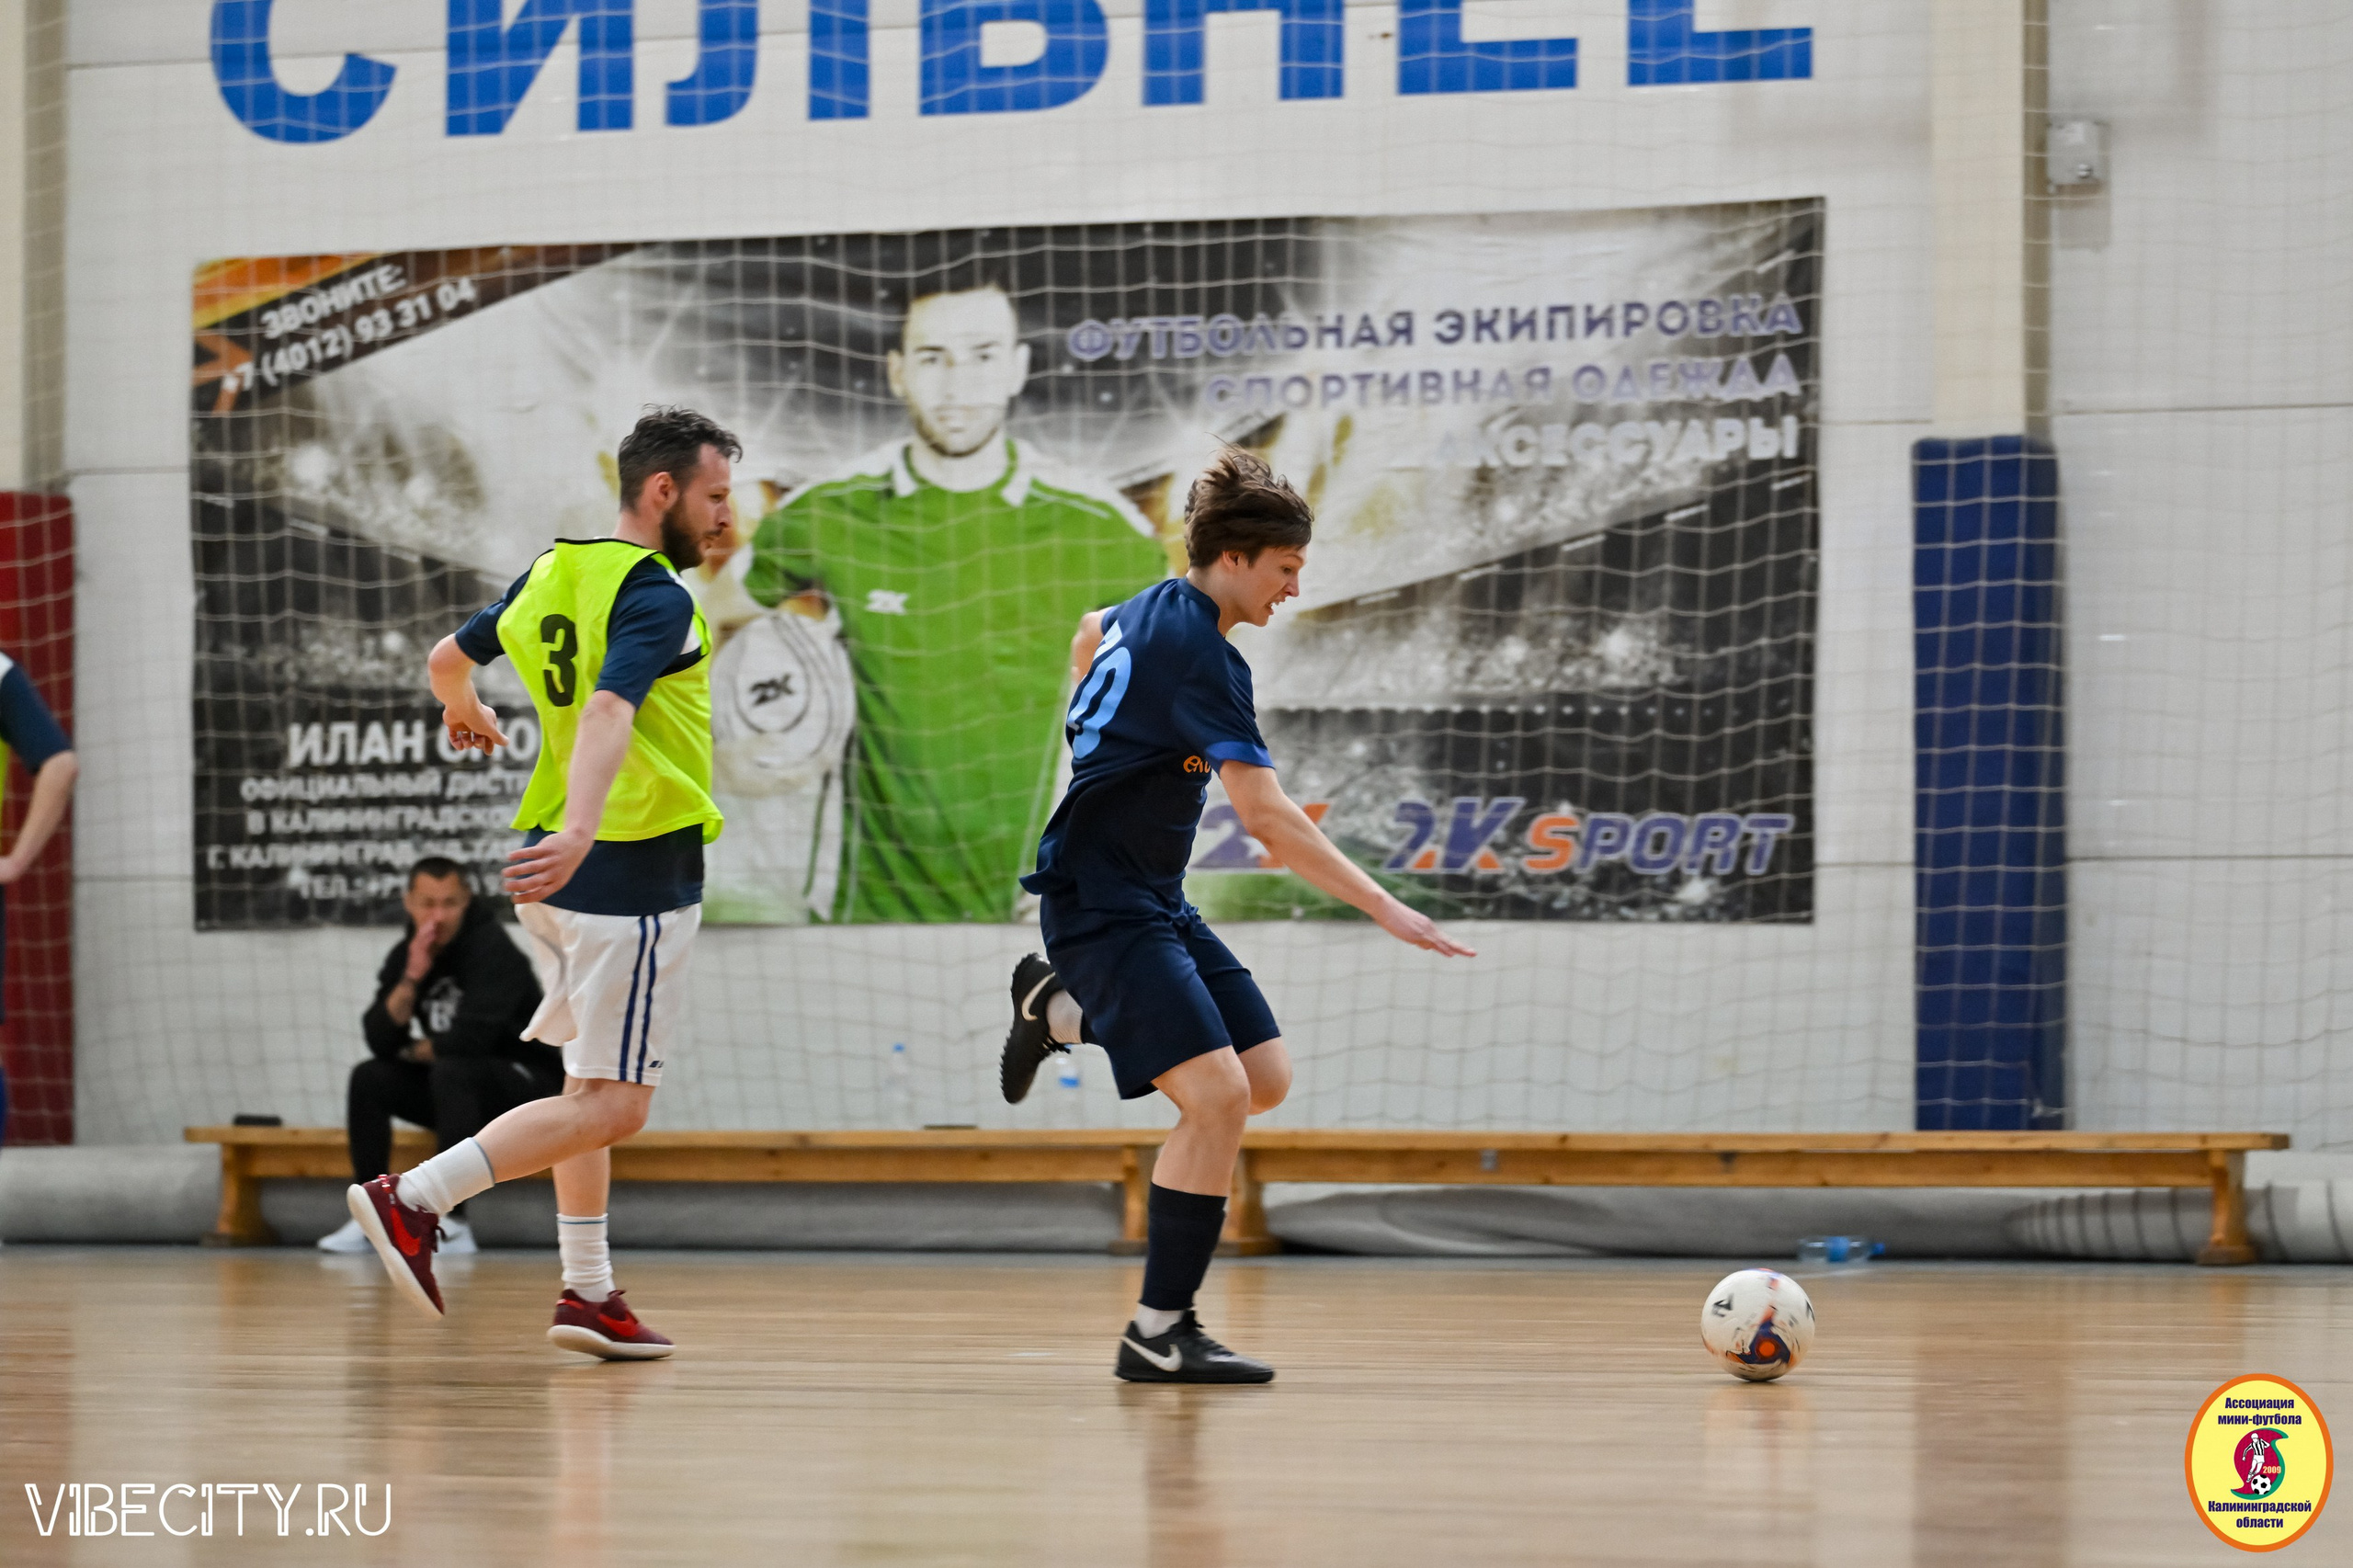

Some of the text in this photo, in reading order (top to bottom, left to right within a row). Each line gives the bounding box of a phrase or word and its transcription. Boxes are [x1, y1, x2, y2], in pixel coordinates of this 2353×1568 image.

[354, 307, 393, 345] 93
[394, 292, 433, 327] 31
[1067, 292, 1802, 360] ФУТБОЛЬНАЯ ЭКИПИРОВКА
[1204, 366, 1553, 412] СПОРТИВНАЯ
[540, 614, 577, 707] 3
[288, 720, 426, 767] ИЛАН
[1384, 796, 1526, 874] 2K
[1521, 812, 1795, 875] SPORT
